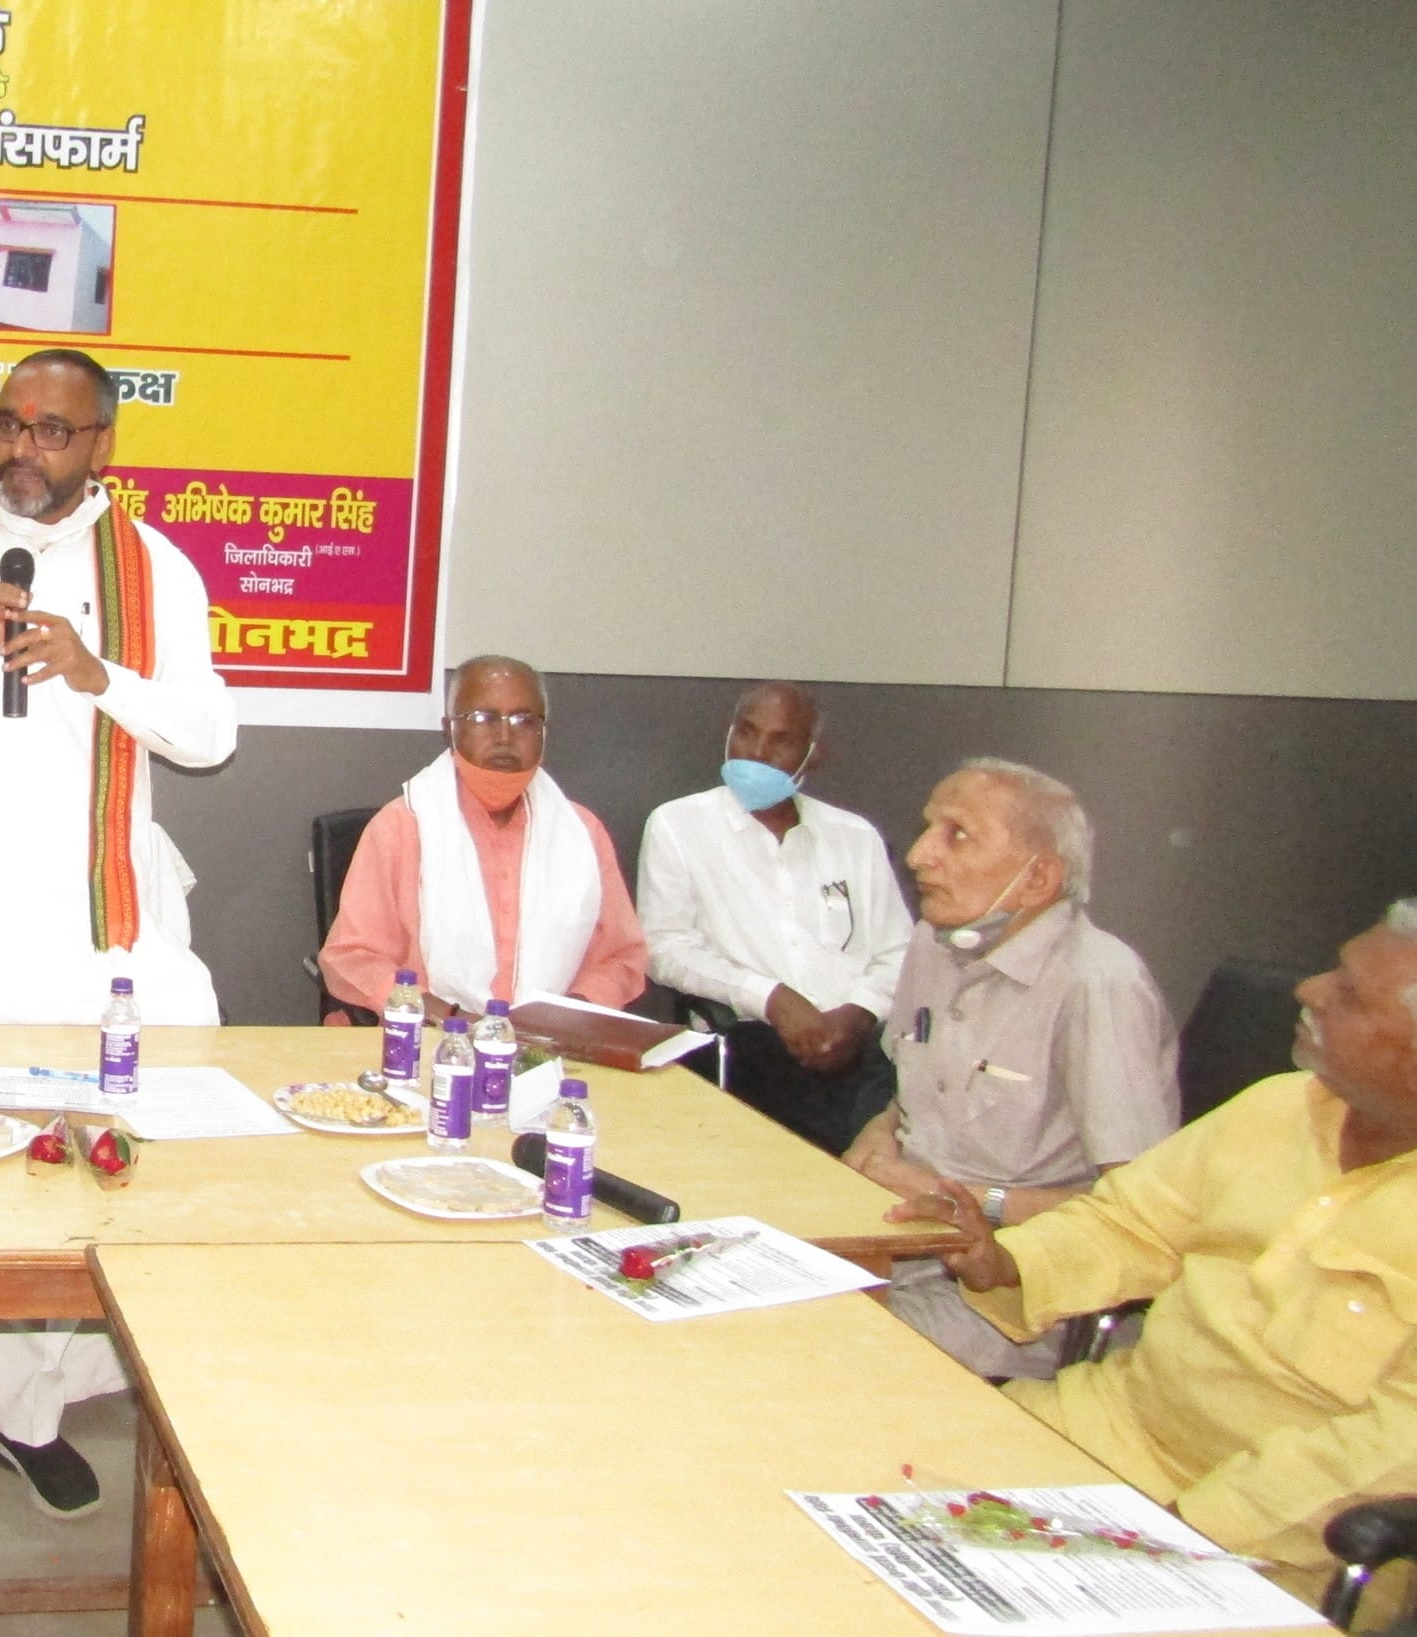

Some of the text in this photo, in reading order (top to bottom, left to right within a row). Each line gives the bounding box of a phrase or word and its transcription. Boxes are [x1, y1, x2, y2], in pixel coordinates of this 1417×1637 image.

[162, 481, 377, 542] अभिषेक कुमार सिंह
[224, 542, 313, 568] जिलाधिकारी
[239, 571, 295, 595] सोनभद्र
